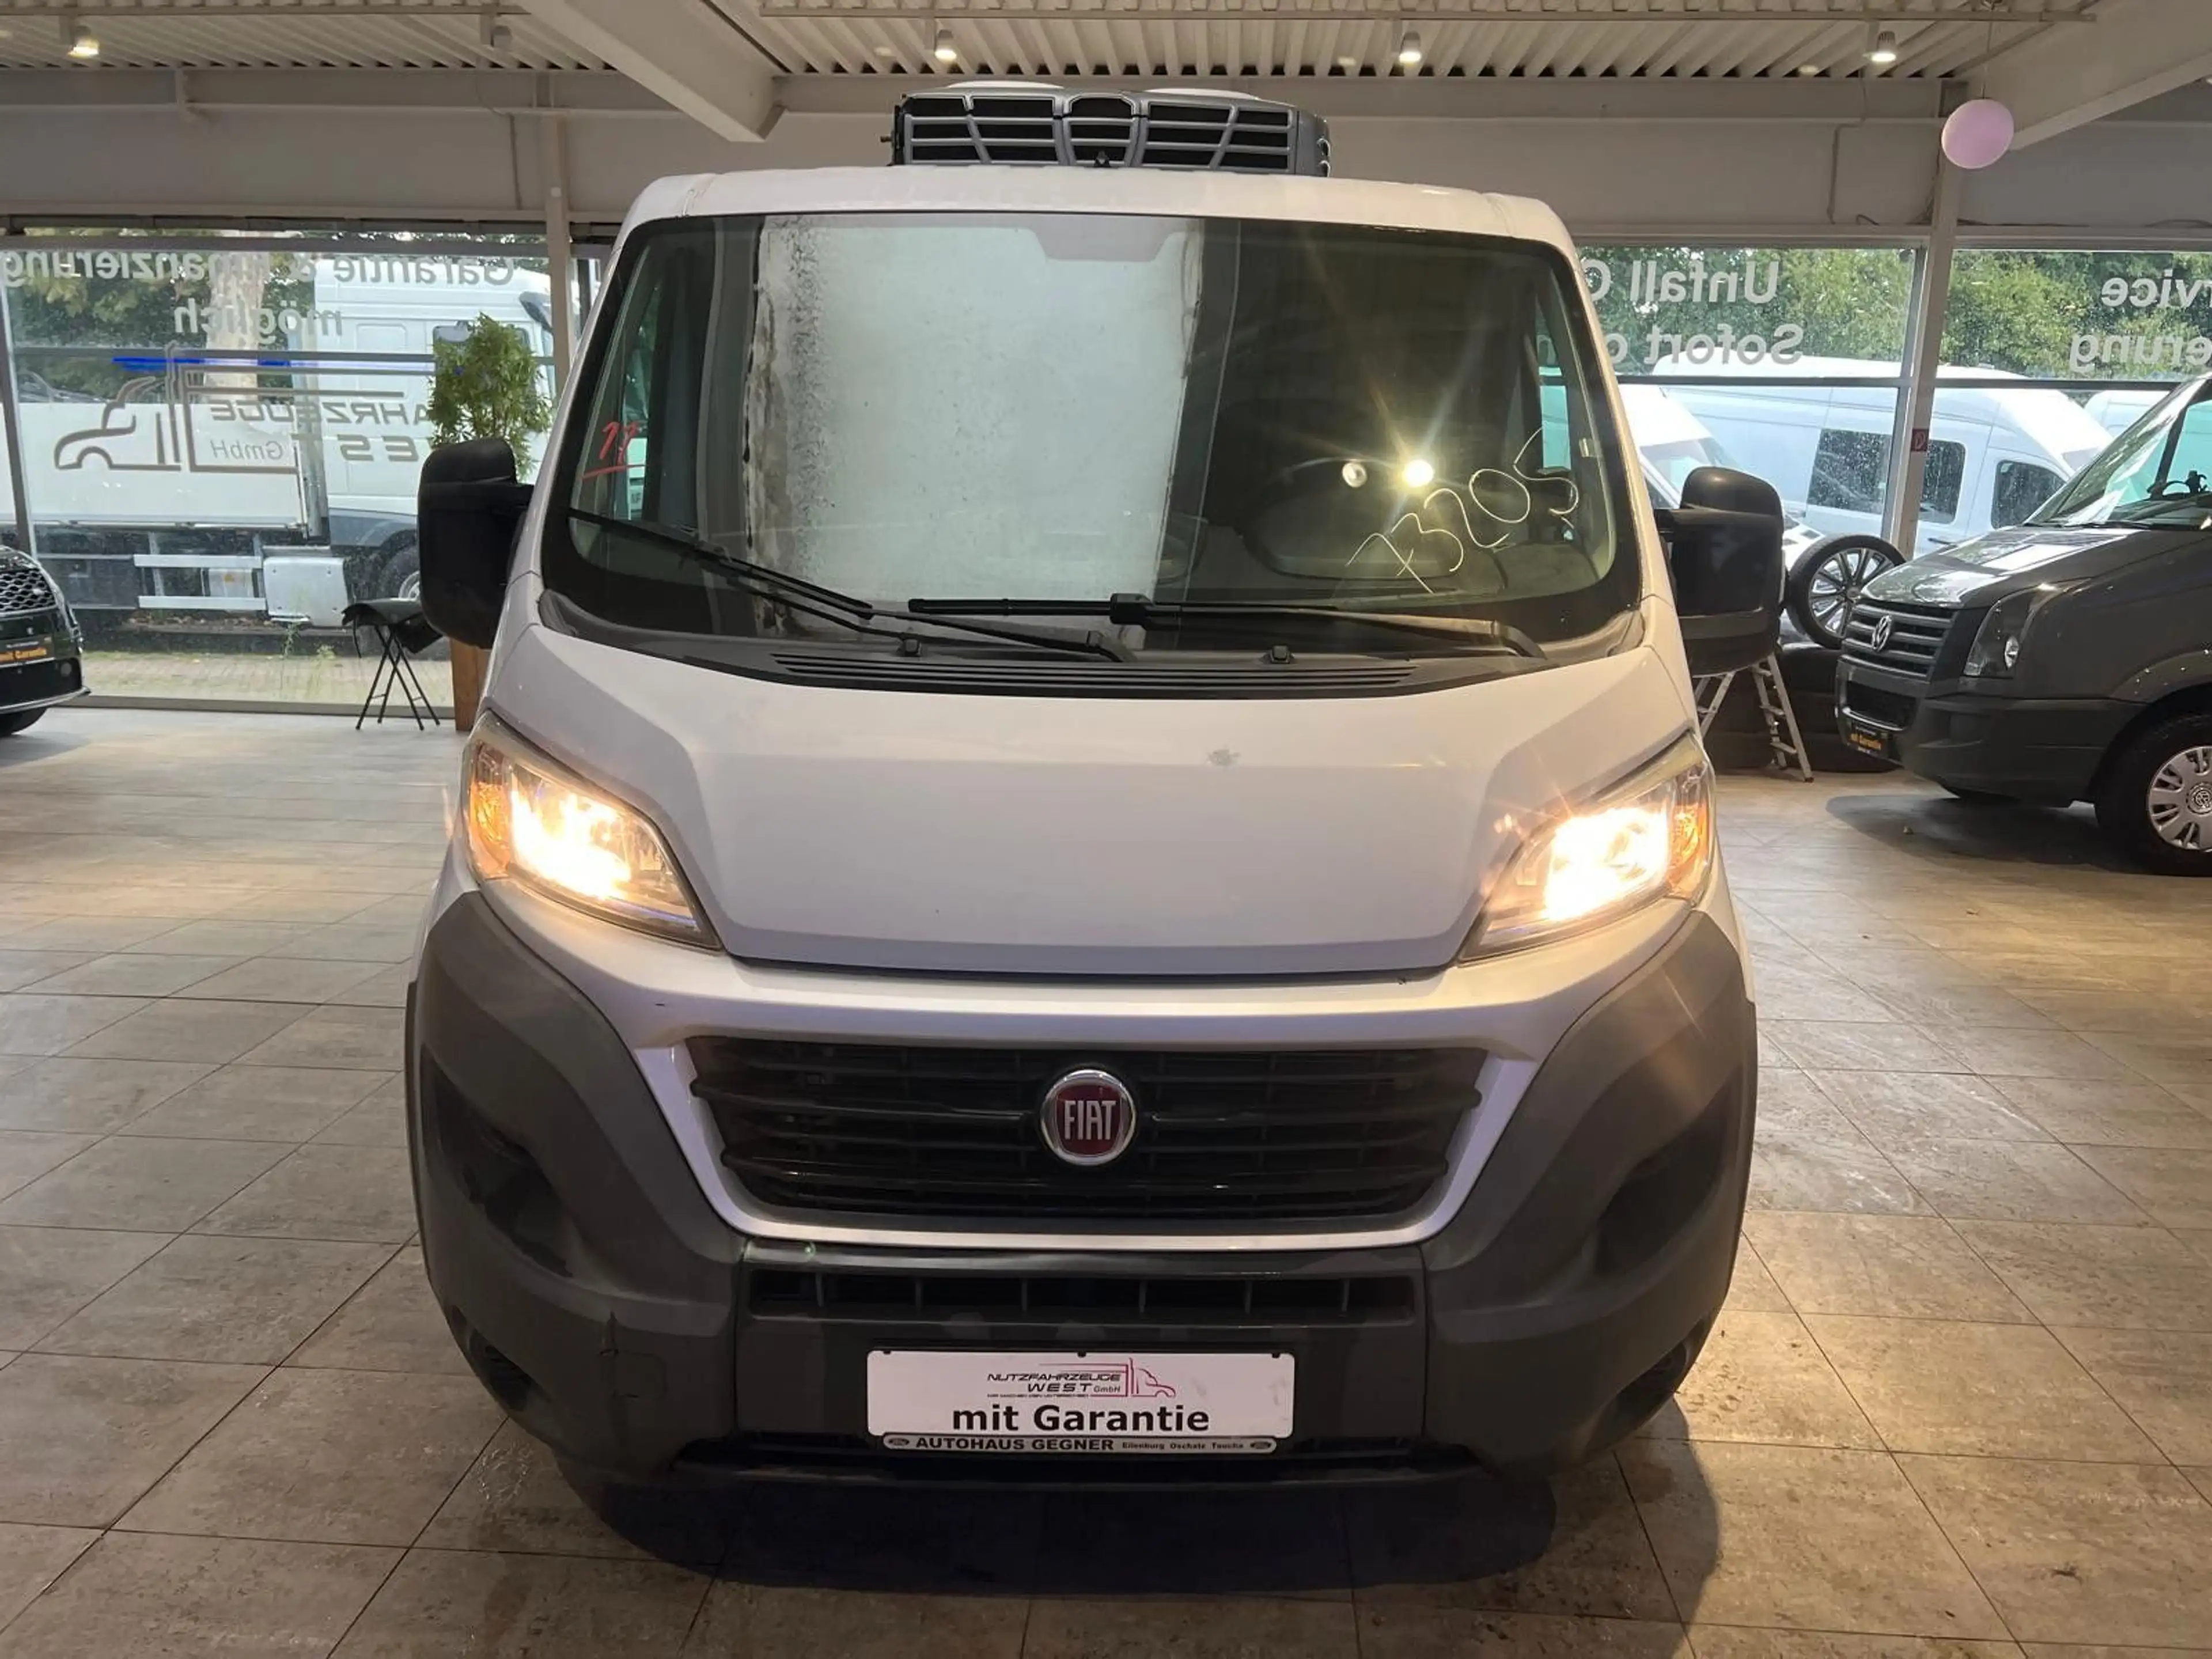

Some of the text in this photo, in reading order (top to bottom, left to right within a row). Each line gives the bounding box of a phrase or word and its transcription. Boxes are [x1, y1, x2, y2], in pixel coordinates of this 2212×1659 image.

[1065, 1100, 1116, 1140] FIAT
[987, 1373, 1121, 1382] NUTZFAHRZEUGE
[1028, 1382, 1121, 1393] WEST GmbH
[953, 1404, 1210, 1432] mit Garantie
[916, 1437, 1024, 1450] AUTOHAUS
[1031, 1438, 1114, 1450] GEGNER
